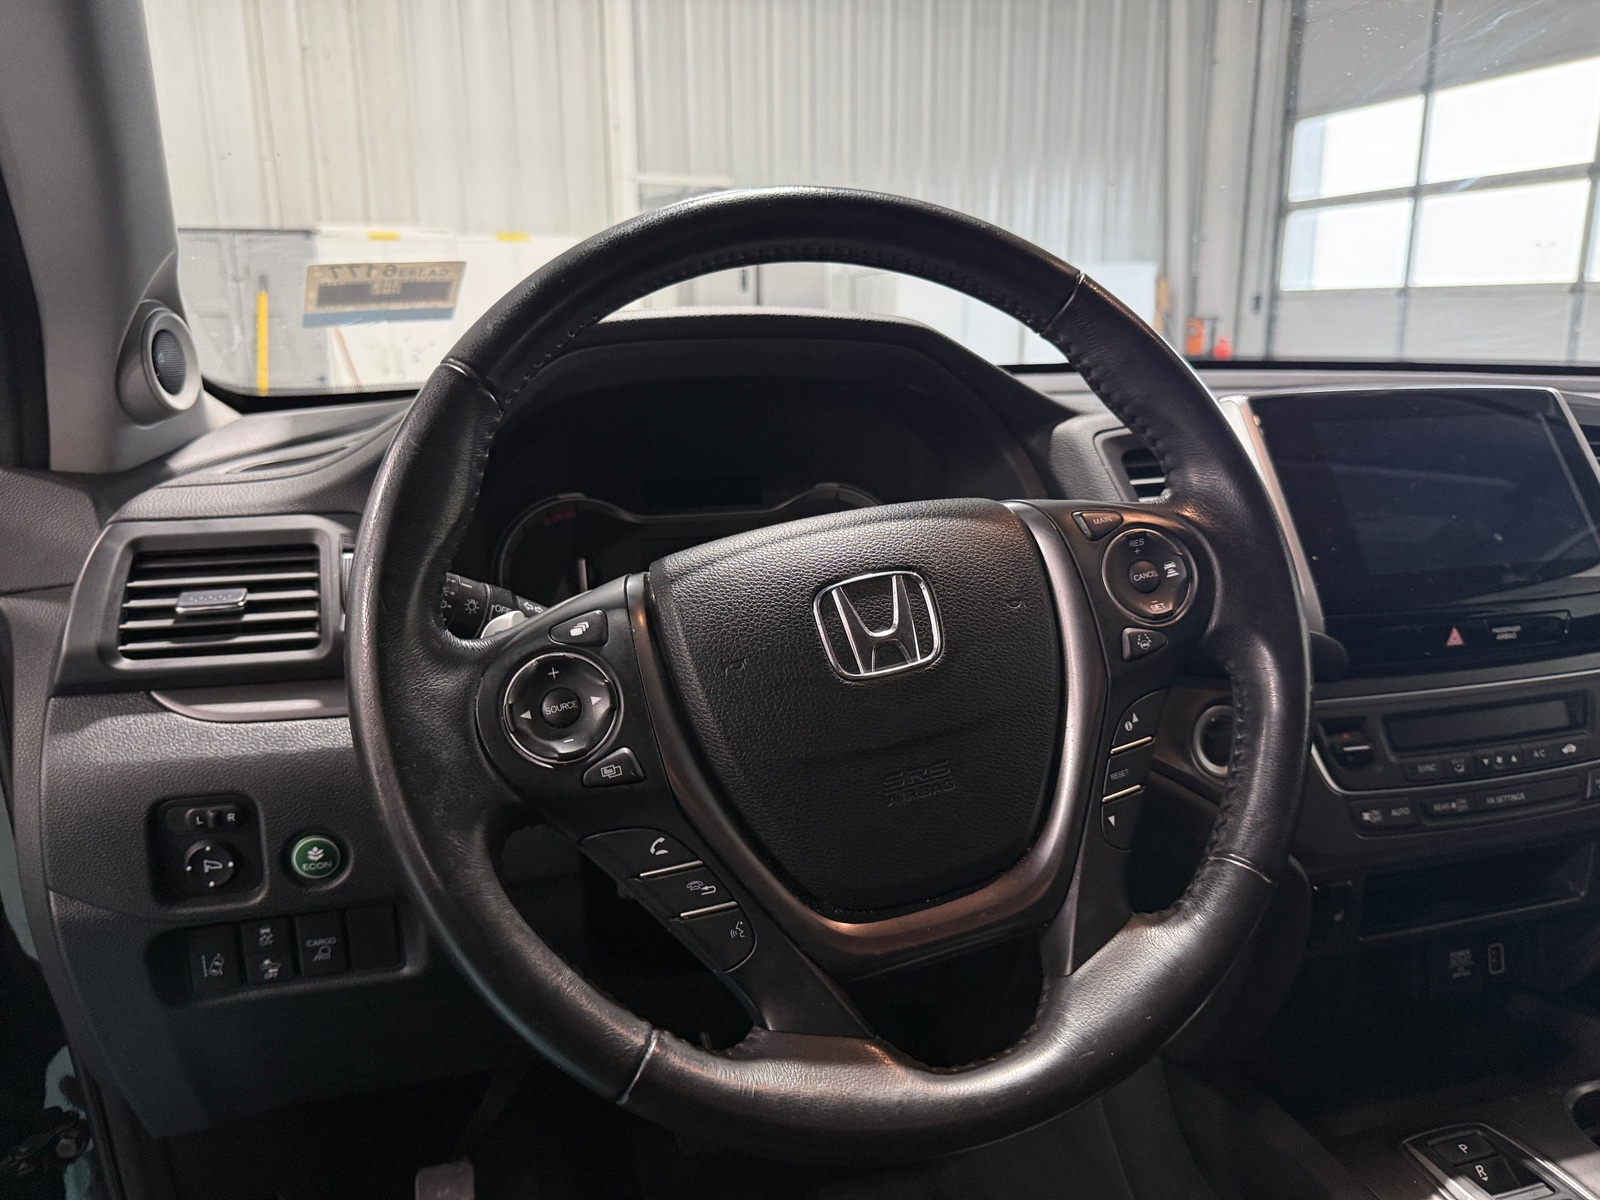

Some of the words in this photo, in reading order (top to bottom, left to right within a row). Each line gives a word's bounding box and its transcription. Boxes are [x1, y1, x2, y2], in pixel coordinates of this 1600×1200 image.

[1092, 516, 1113, 526] MAIN
[1129, 538, 1145, 548] RES
[1133, 570, 1159, 582] CANCEL
[1150, 602, 1165, 611] SET
[545, 700, 579, 716] SOURCE
[882, 760, 951, 791] SRS
[1110, 768, 1130, 780] RESET
[195, 815, 204, 825] L
[226, 813, 236, 823] R
[302, 859, 333, 871] ECON
[306, 936, 338, 948] CARGO
[1457, 1143, 1469, 1154] P
[1475, 1165, 1487, 1178] R
